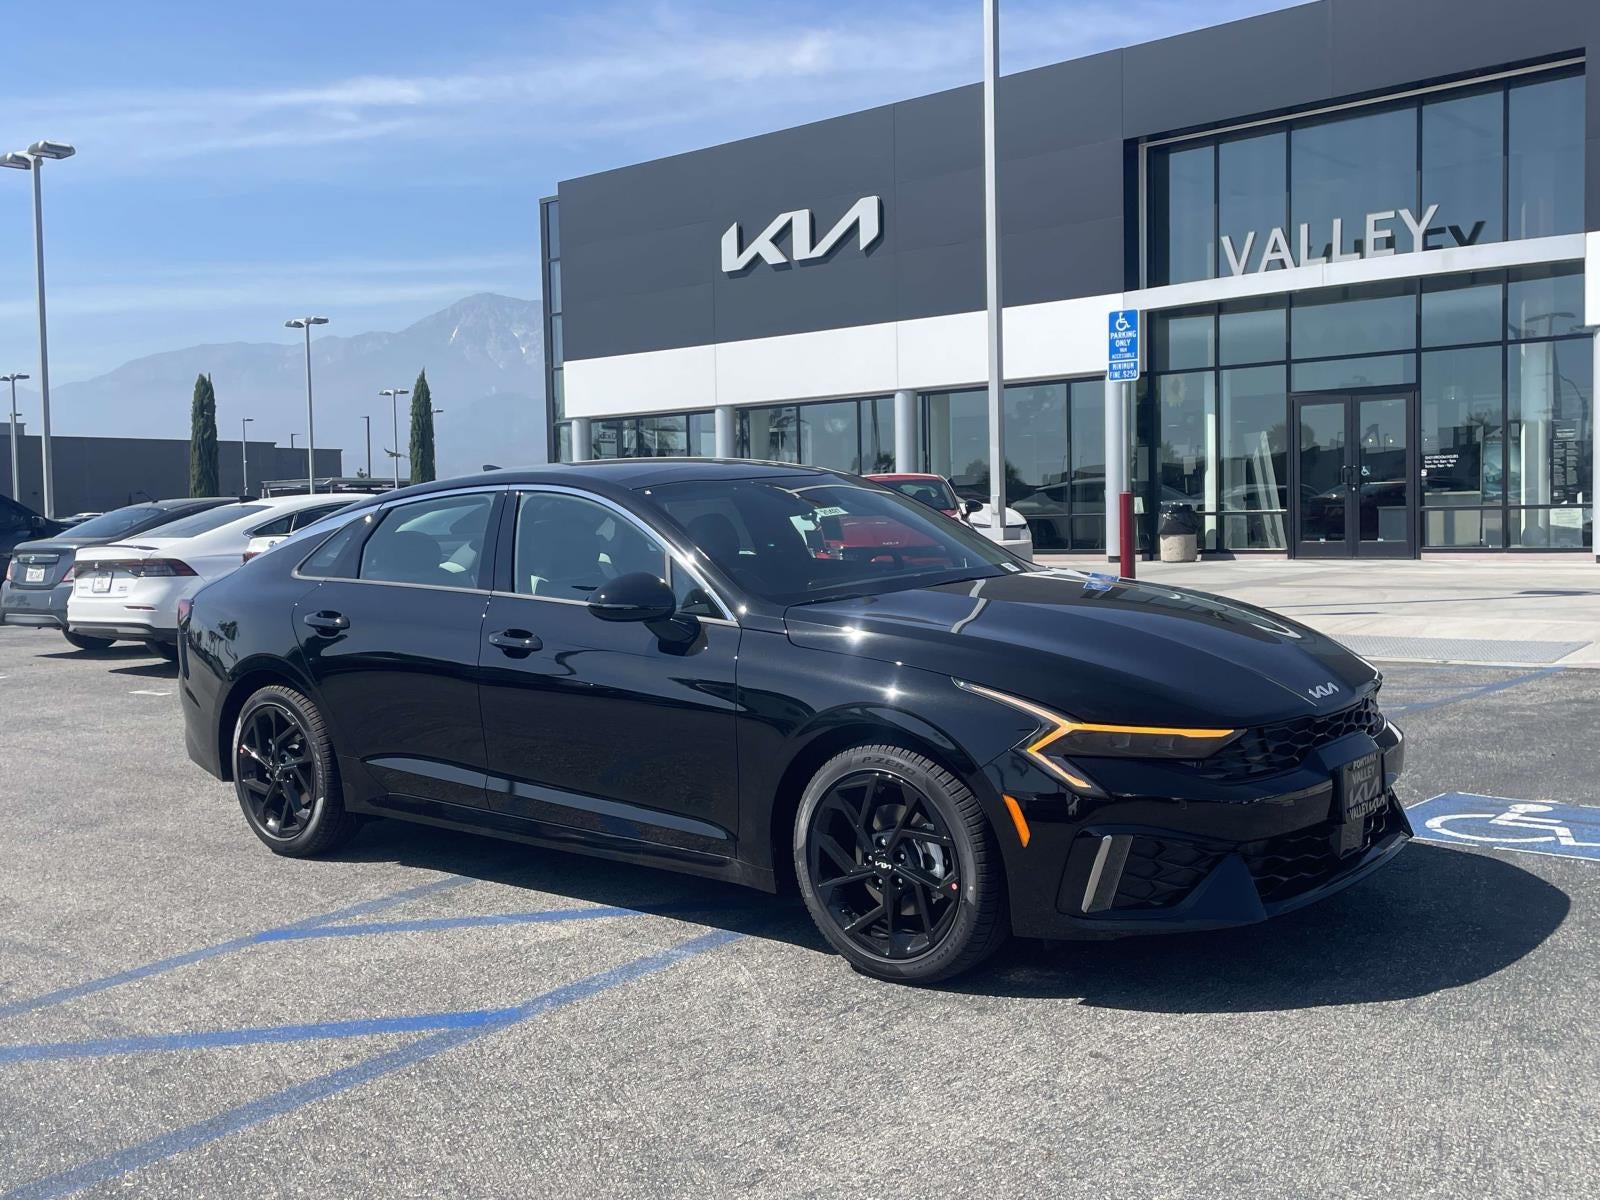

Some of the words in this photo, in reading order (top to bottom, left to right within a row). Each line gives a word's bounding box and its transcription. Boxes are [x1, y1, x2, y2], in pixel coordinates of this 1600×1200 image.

[721, 195, 880, 273] KIA
[1220, 203, 1440, 277] VALLEY
[1110, 330, 1136, 340] PARKING
[1115, 339, 1131, 347] ONLY
[1112, 362, 1135, 371] MINIMUM
[1123, 369, 1137, 378] $250
